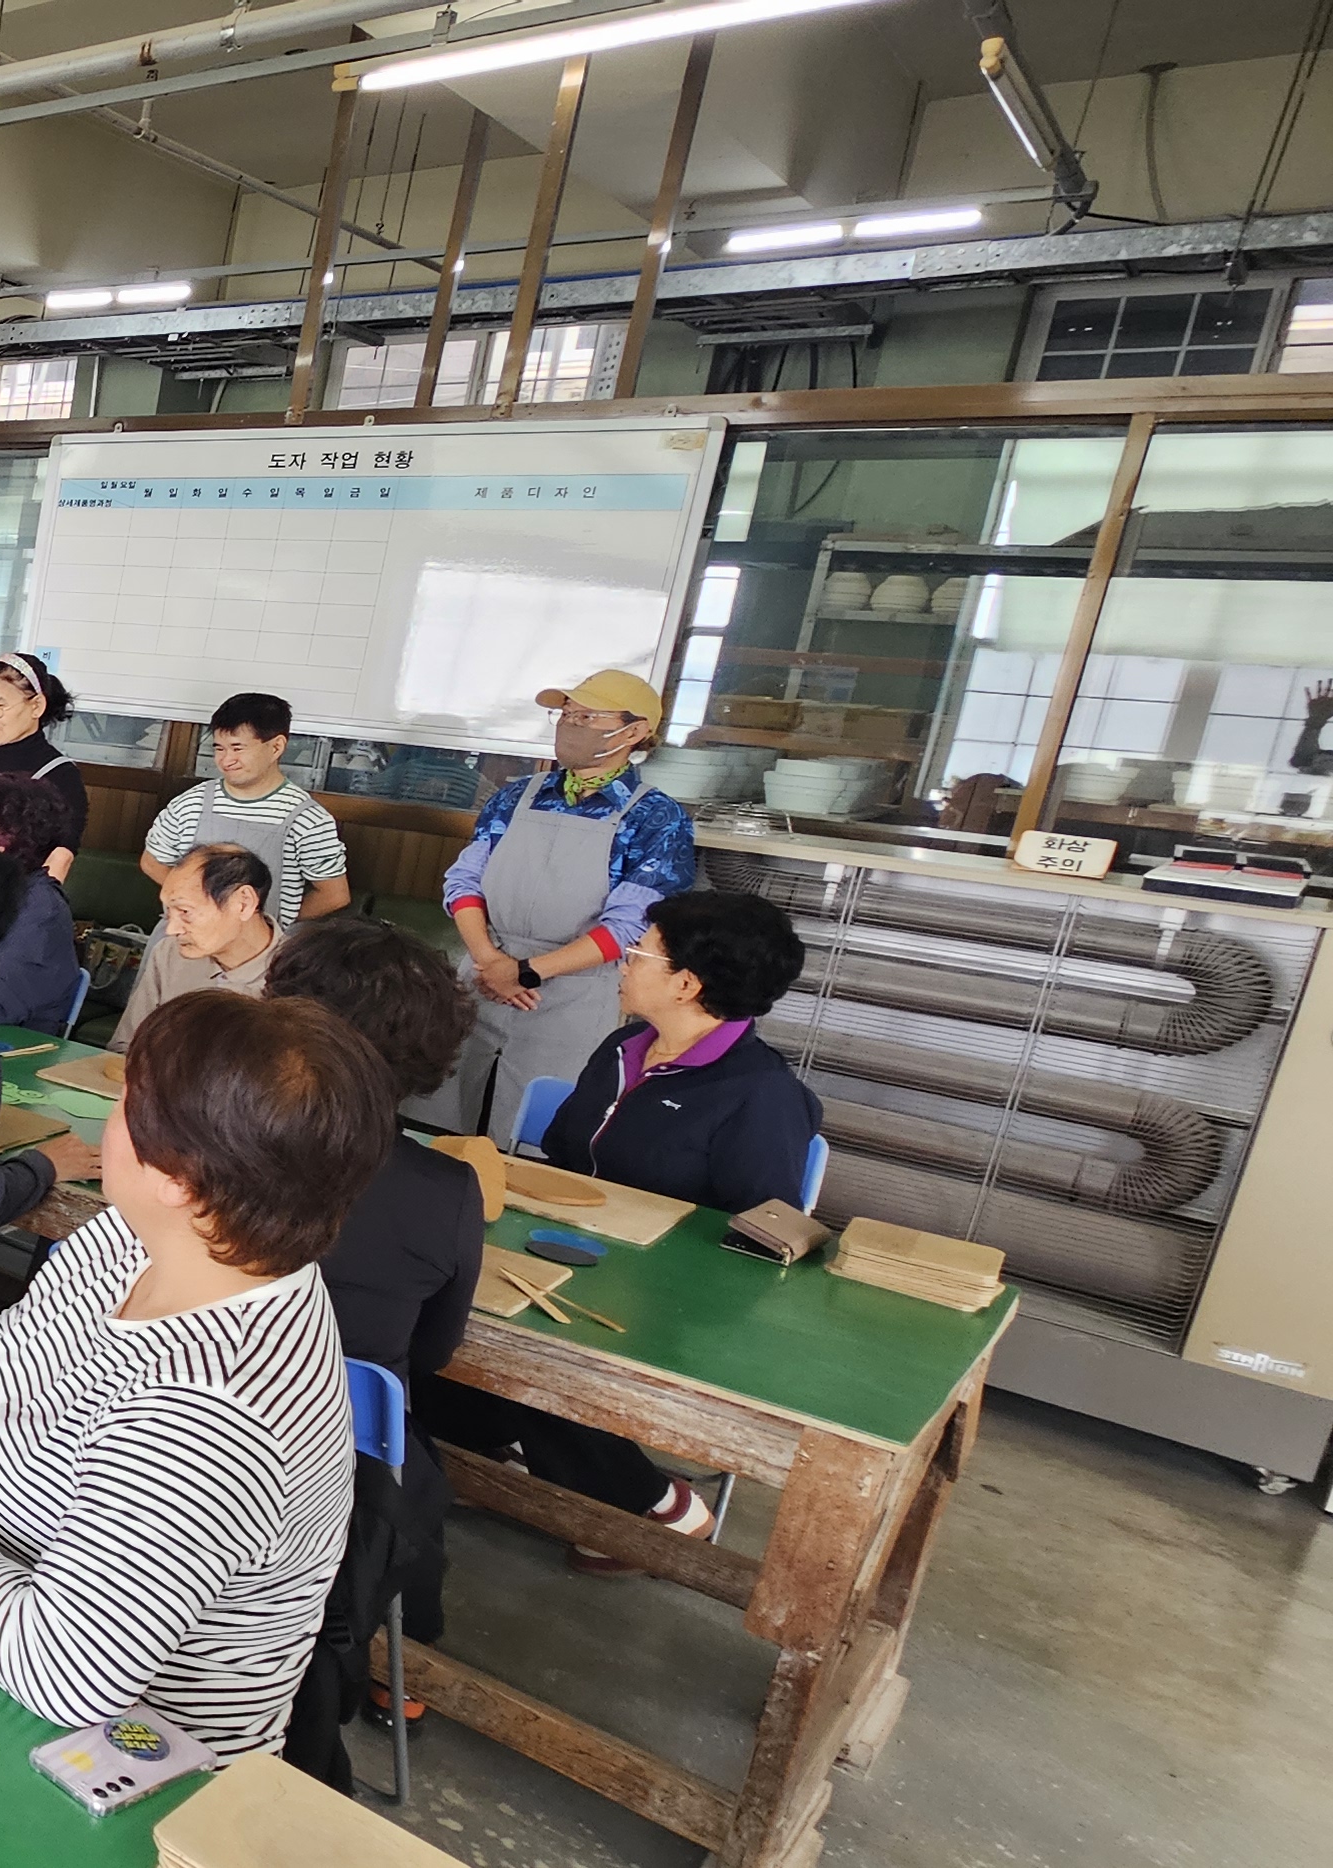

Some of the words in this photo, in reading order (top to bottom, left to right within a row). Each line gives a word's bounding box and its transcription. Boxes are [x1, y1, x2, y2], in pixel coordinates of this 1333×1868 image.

[268, 452, 306, 470] 도자
[321, 452, 358, 470] 작업
[373, 451, 414, 469] 현황
[1041, 835, 1092, 853] 화상
[1036, 855, 1083, 872] 주의
